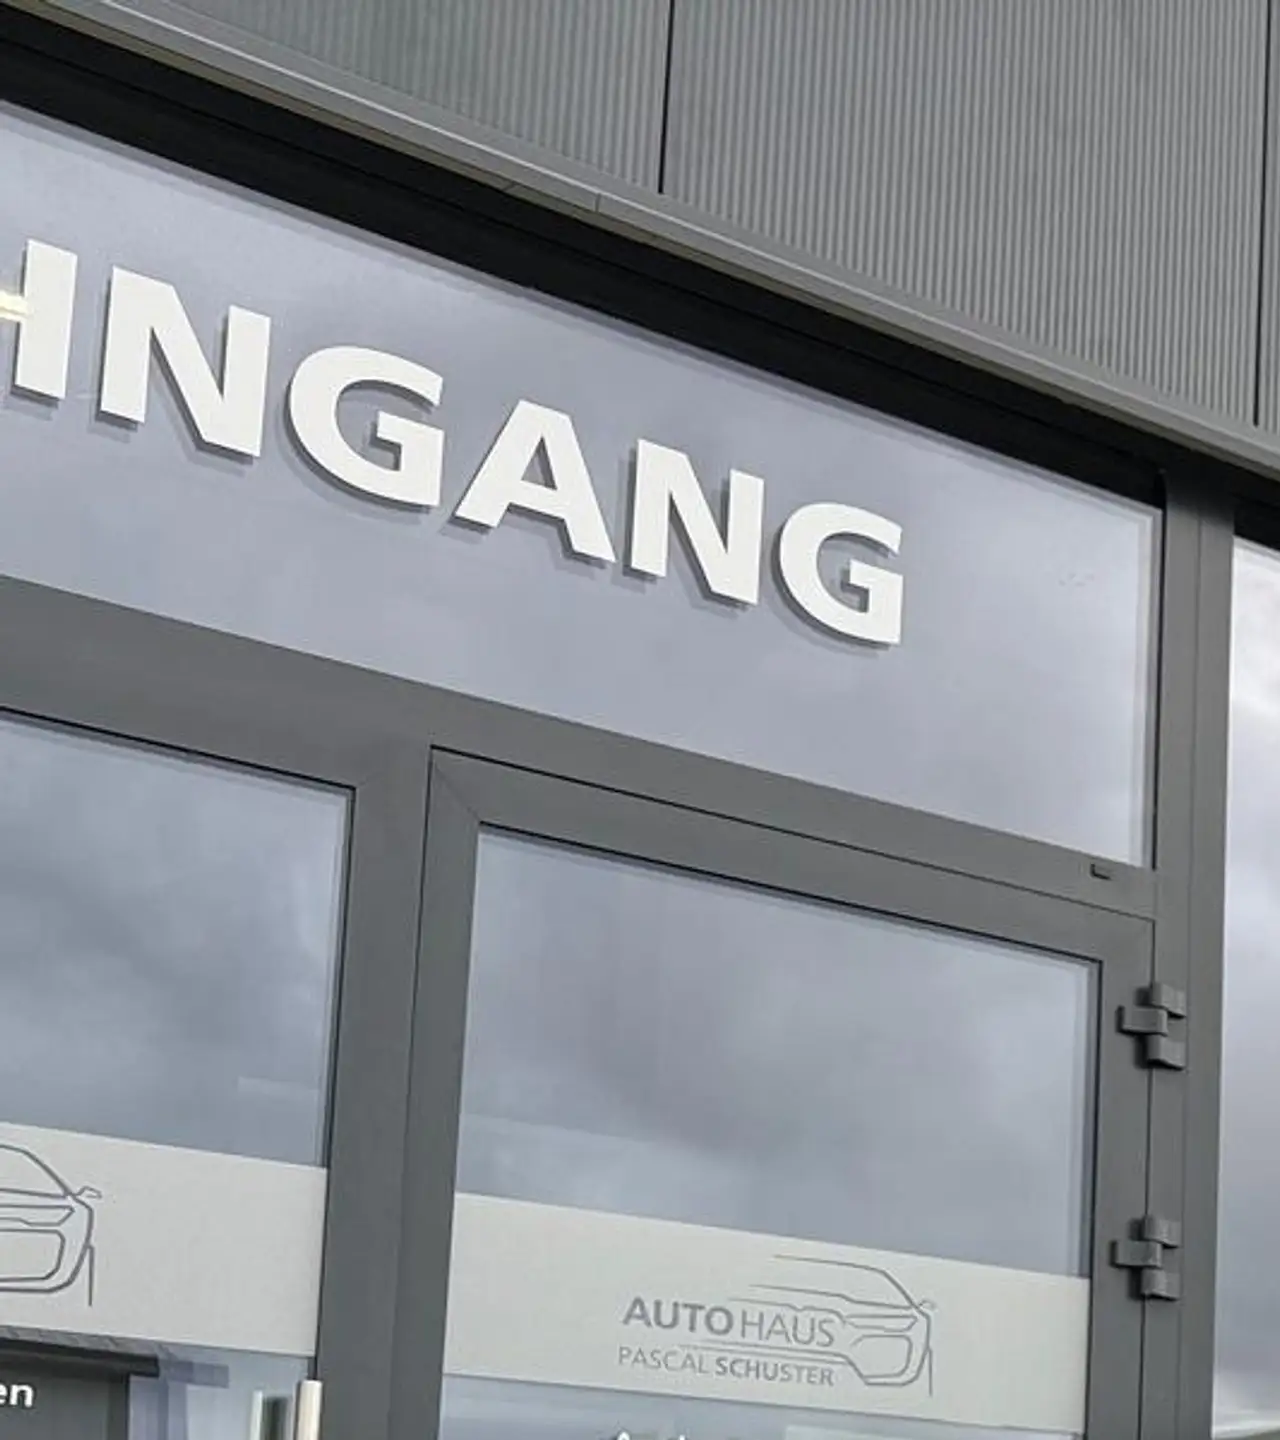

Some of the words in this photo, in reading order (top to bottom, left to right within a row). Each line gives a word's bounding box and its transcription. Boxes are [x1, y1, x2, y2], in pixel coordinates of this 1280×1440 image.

[622, 1296, 836, 1348] AUTOHAUS
[618, 1346, 709, 1374] PASCAL
[715, 1356, 835, 1386] SCHUSTER
